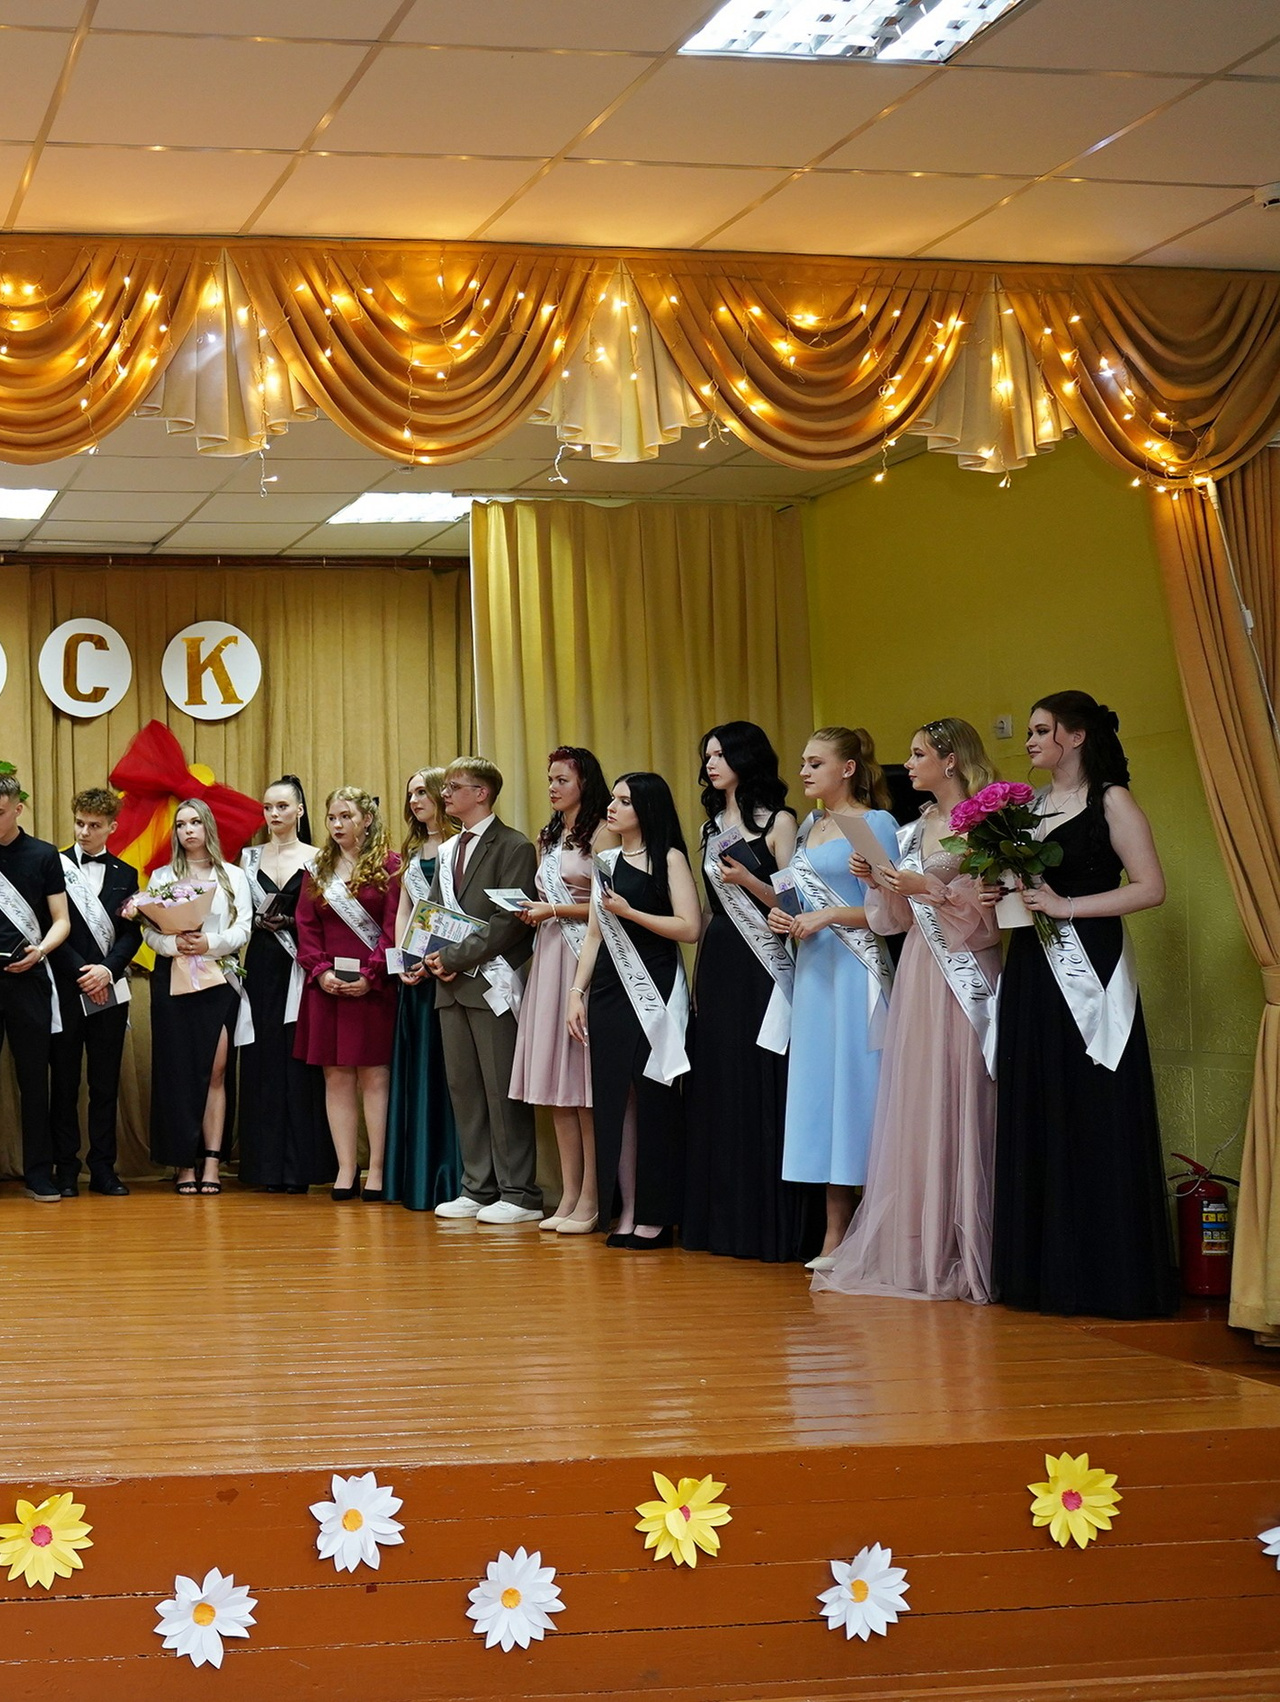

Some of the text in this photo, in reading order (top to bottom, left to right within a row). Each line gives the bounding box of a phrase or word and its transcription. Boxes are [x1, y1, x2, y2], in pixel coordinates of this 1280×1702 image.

[754, 930, 790, 973] 2024
[854, 930, 889, 978] 2024
[627, 972, 659, 1013] 2024
[945, 954, 989, 1002] 2024
